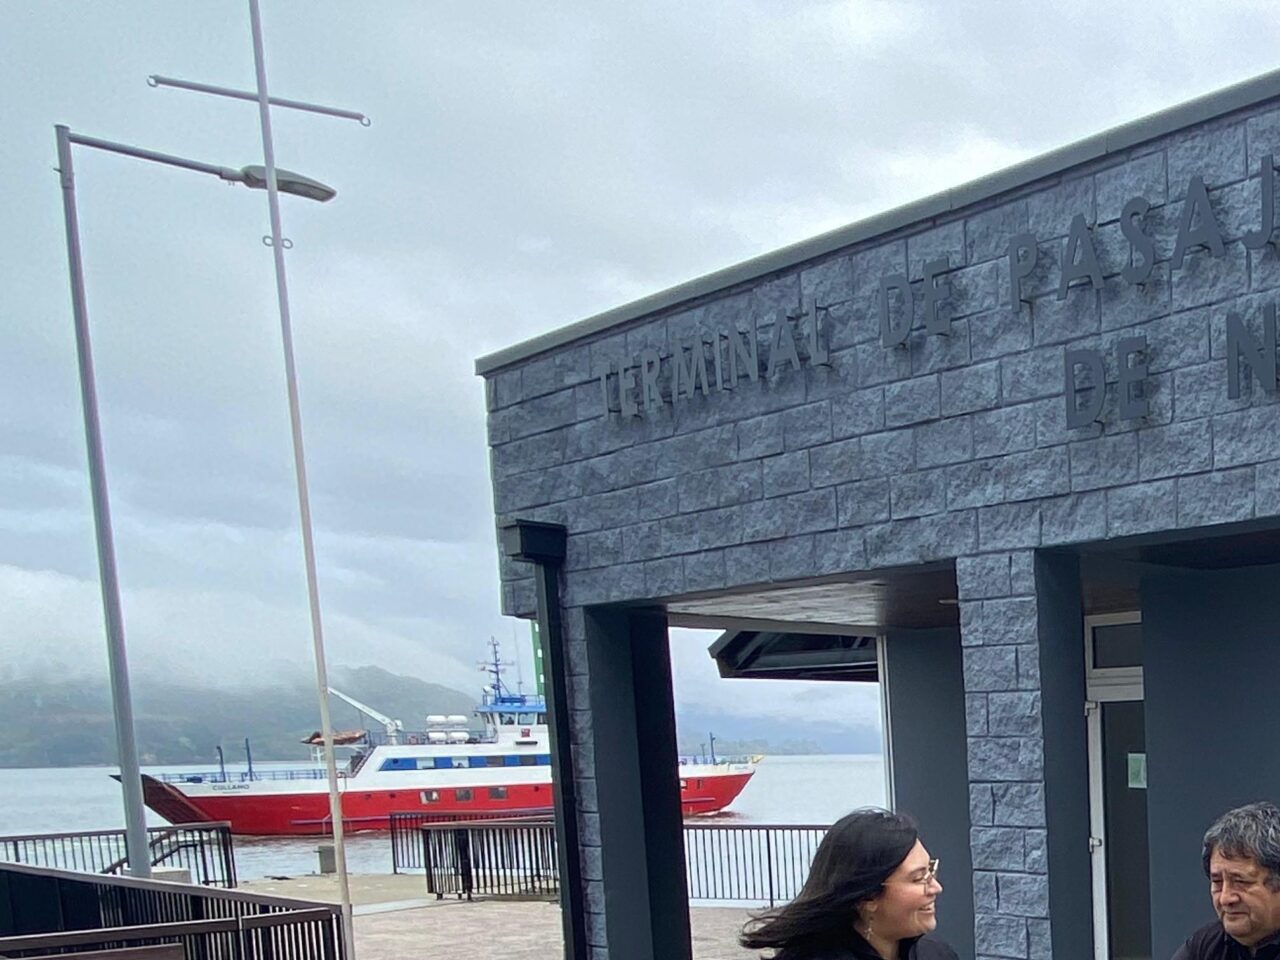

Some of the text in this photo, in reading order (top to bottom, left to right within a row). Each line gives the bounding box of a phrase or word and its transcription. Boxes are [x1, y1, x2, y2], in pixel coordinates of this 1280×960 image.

[599, 299, 829, 418] TERMINAL
[880, 256, 952, 350] DE
[1064, 335, 1151, 430] DE
